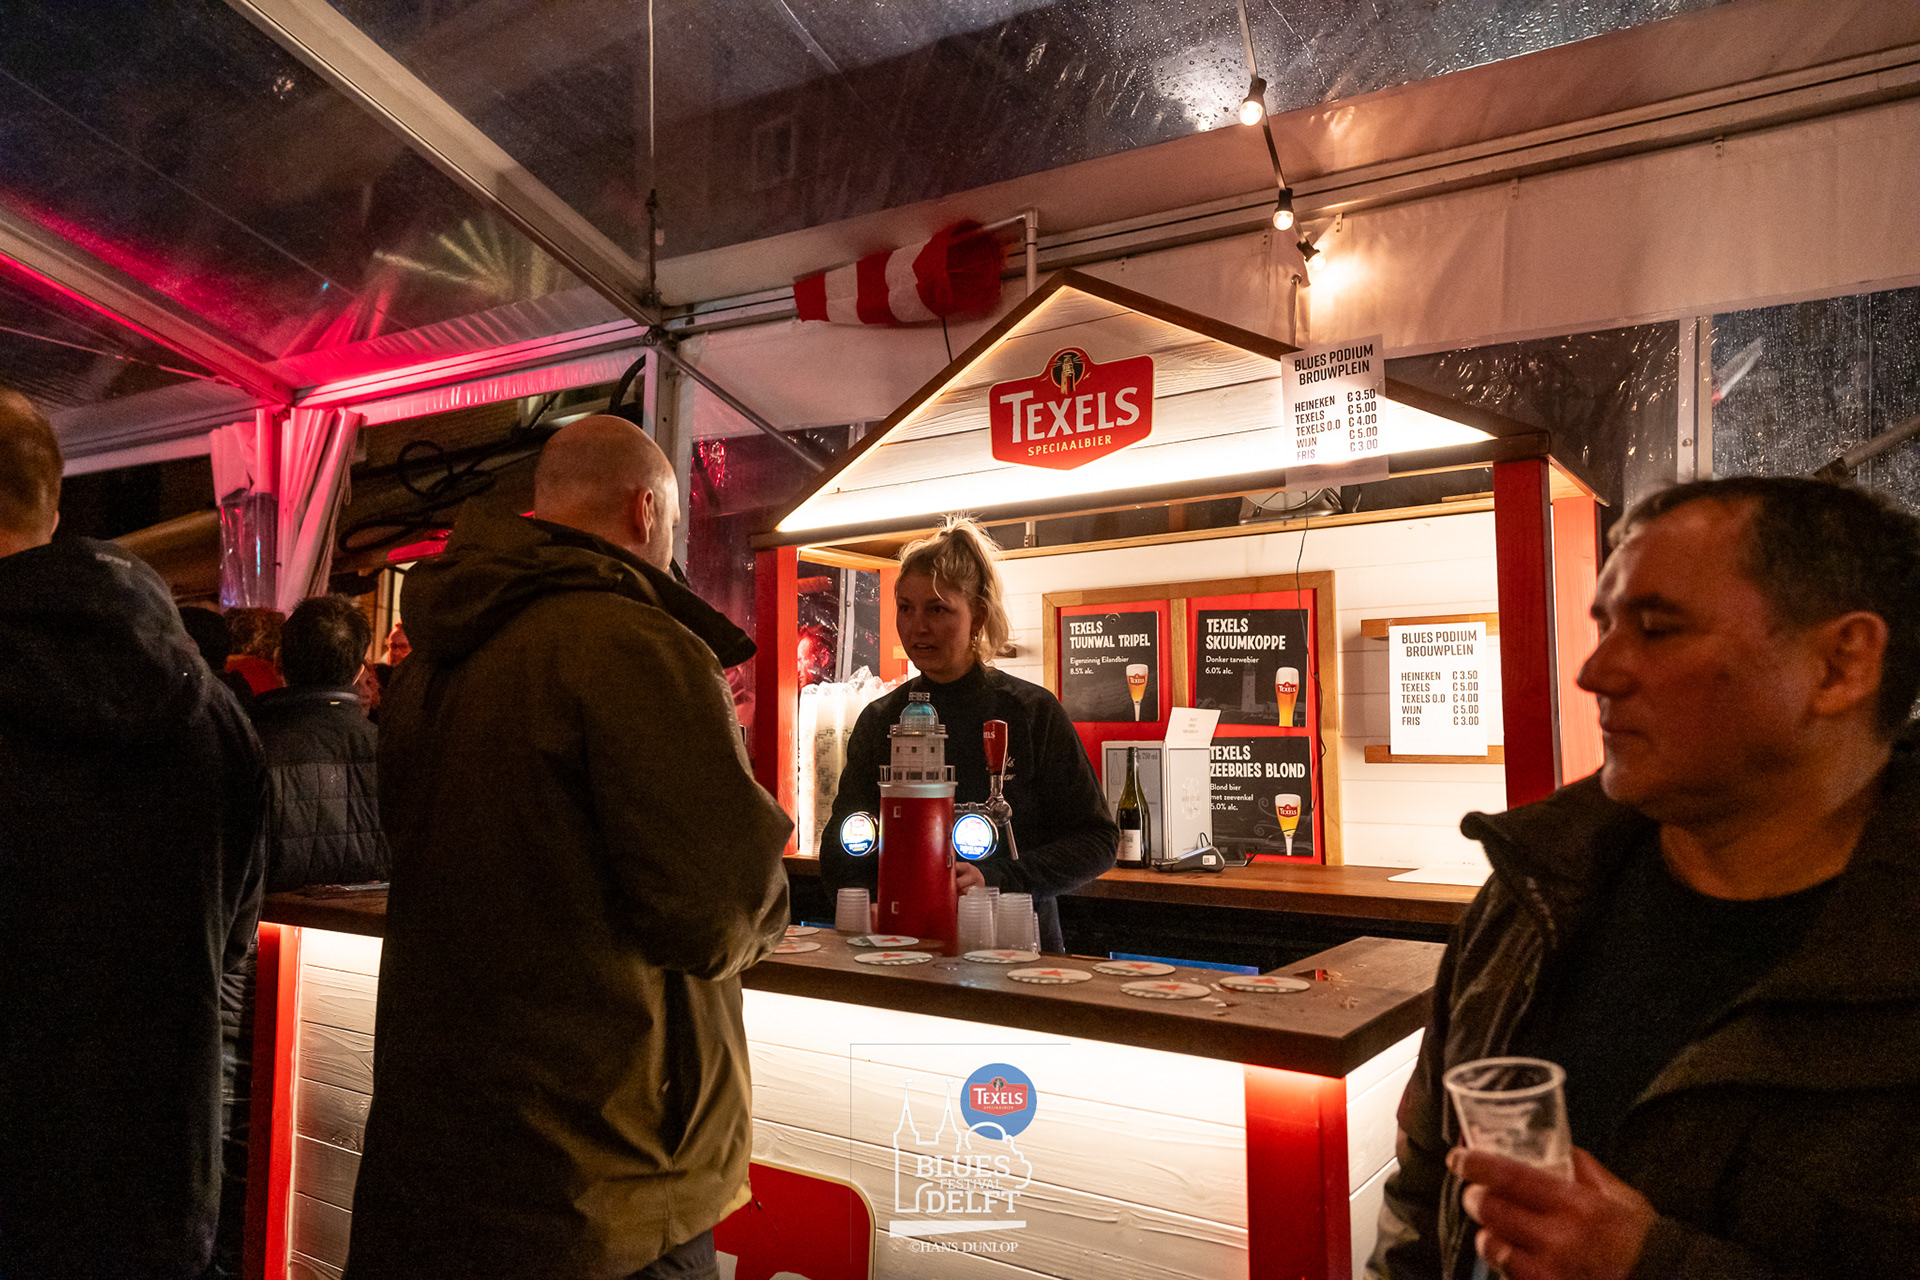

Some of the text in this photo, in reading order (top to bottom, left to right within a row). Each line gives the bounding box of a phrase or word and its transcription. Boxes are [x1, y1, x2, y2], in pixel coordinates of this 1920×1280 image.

[1294, 344, 1374, 372] BLUES PODIUM
[1299, 360, 1370, 385] BROUWPLEIN
[1295, 395, 1335, 412] HEINEKEN
[1355, 388, 1376, 401] 3.50
[1000, 387, 1140, 443] TEXELS
[1295, 410, 1325, 425] TEXELS
[1356, 401, 1377, 414] 5.00
[1296, 422, 1325, 437] TEXELS
[1327, 419, 1341, 431] 0.0
[1357, 414, 1377, 426] 4.00
[1028, 434, 1112, 456] SPECIAALBIER
[1296, 437, 1317, 449] WIJN
[1357, 426, 1378, 439] 5.00
[1297, 449, 1316, 461] FRIS
[1358, 439, 1378, 451] 3.00
[1069, 621, 1103, 635] TEXELS
[1206, 618, 1249, 633] TEXELS
[1069, 633, 1151, 649] TUUNWAL TRIPEL
[1205, 635, 1286, 650] SKUUMKOPPE
[1402, 630, 1477, 644] BLUES PODIUM
[1406, 644, 1474, 657] BROUWPLEIN
[1070, 657, 1101, 666] Eigenzinnig
[1206, 655, 1229, 663] Donker
[1401, 671, 1441, 681] HEINEKEN
[1460, 670, 1478, 680] 3.50
[1401, 683, 1431, 692] TEXELS
[1460, 681, 1479, 691] 5.00
[1401, 694, 1431, 704] TEXELS
[1432, 694, 1446, 703] 0.0
[1460, 693, 1479, 703] 4.00
[1401, 706, 1422, 715] WIJN
[1460, 704, 1479, 714] 5.00
[1402, 717, 1421, 726] FRIS
[1461, 716, 1479, 726] 3.00
[1209, 745, 1251, 760] TEXELS
[1210, 762, 1306, 778] ZEEBRIES BLOND
[1210, 783, 1228, 791] Blond
